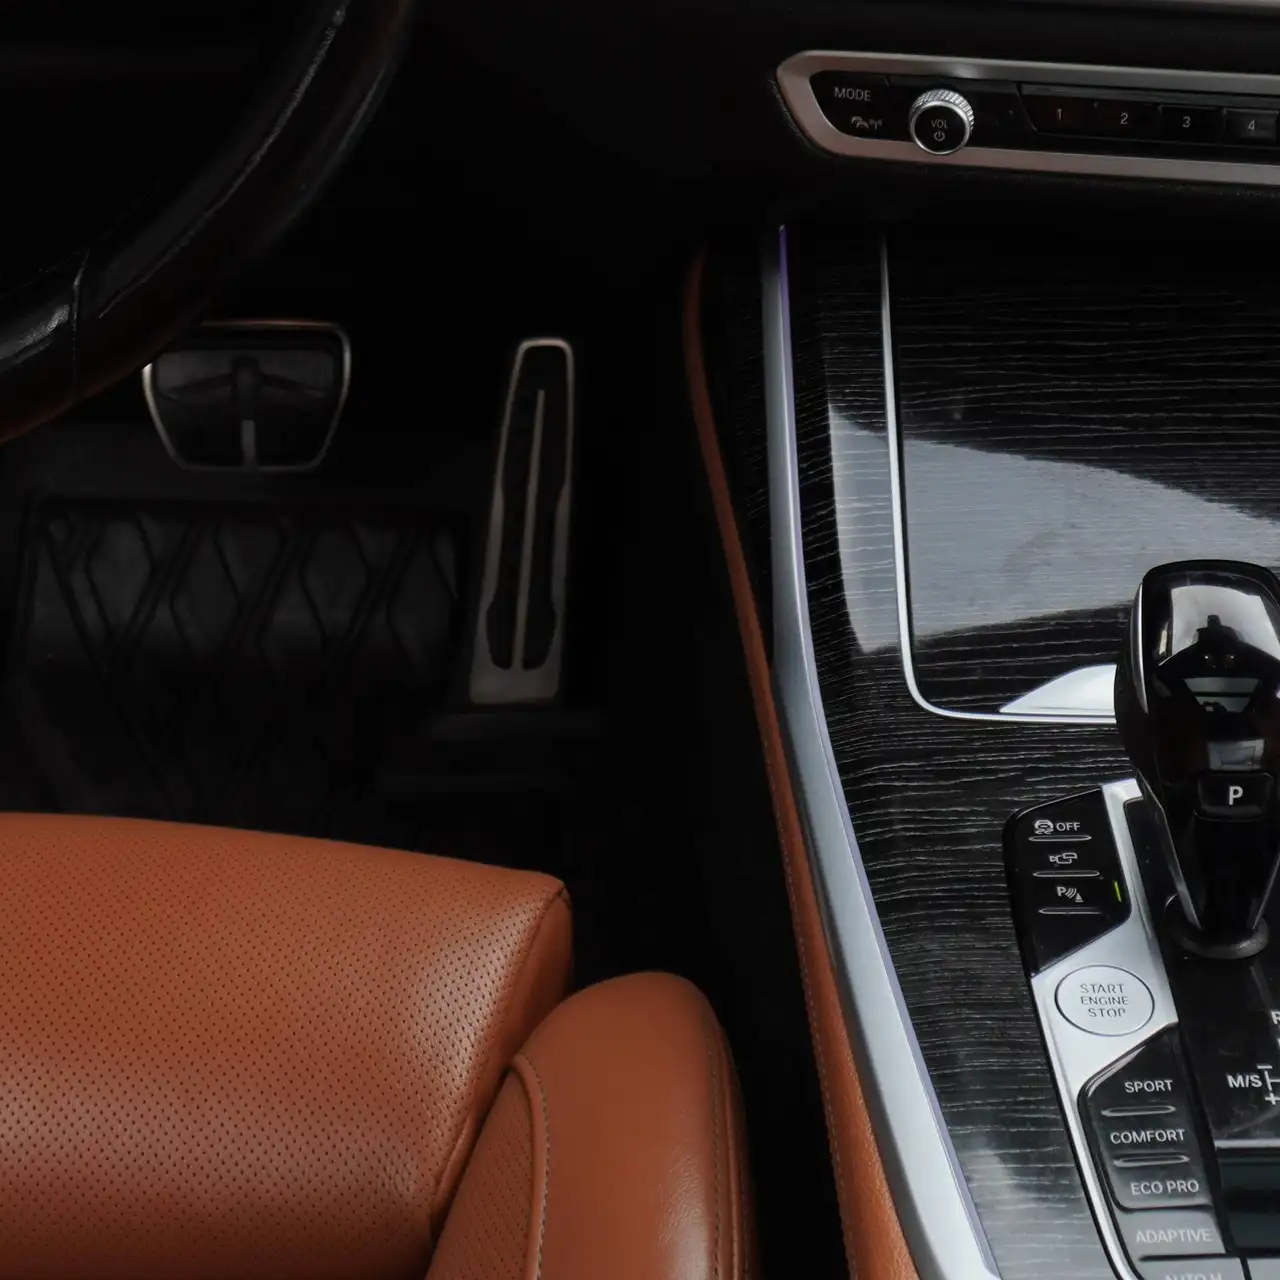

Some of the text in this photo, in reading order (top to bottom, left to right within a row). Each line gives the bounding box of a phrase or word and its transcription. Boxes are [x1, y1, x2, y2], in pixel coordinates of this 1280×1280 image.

[834, 86, 872, 102] MODE
[1056, 108, 1063, 120] 1
[1119, 113, 1129, 125] 2
[931, 119, 948, 129] VOL
[1182, 116, 1192, 129] 3
[1247, 119, 1256, 132] 4
[1228, 786, 1244, 806] P
[1056, 822, 1080, 832] OFF
[1080, 983, 1124, 994] START
[1080, 996, 1129, 1006] ENGINE
[1088, 1007, 1126, 1018] STOP
[1124, 1079, 1173, 1094] SPORT
[1227, 1074, 1263, 1088] M/S
[1110, 1128, 1186, 1144] COMFORT
[1130, 1179, 1200, 1195] ECO PRO
[1136, 1228, 1213, 1244] ADAPTIVE
